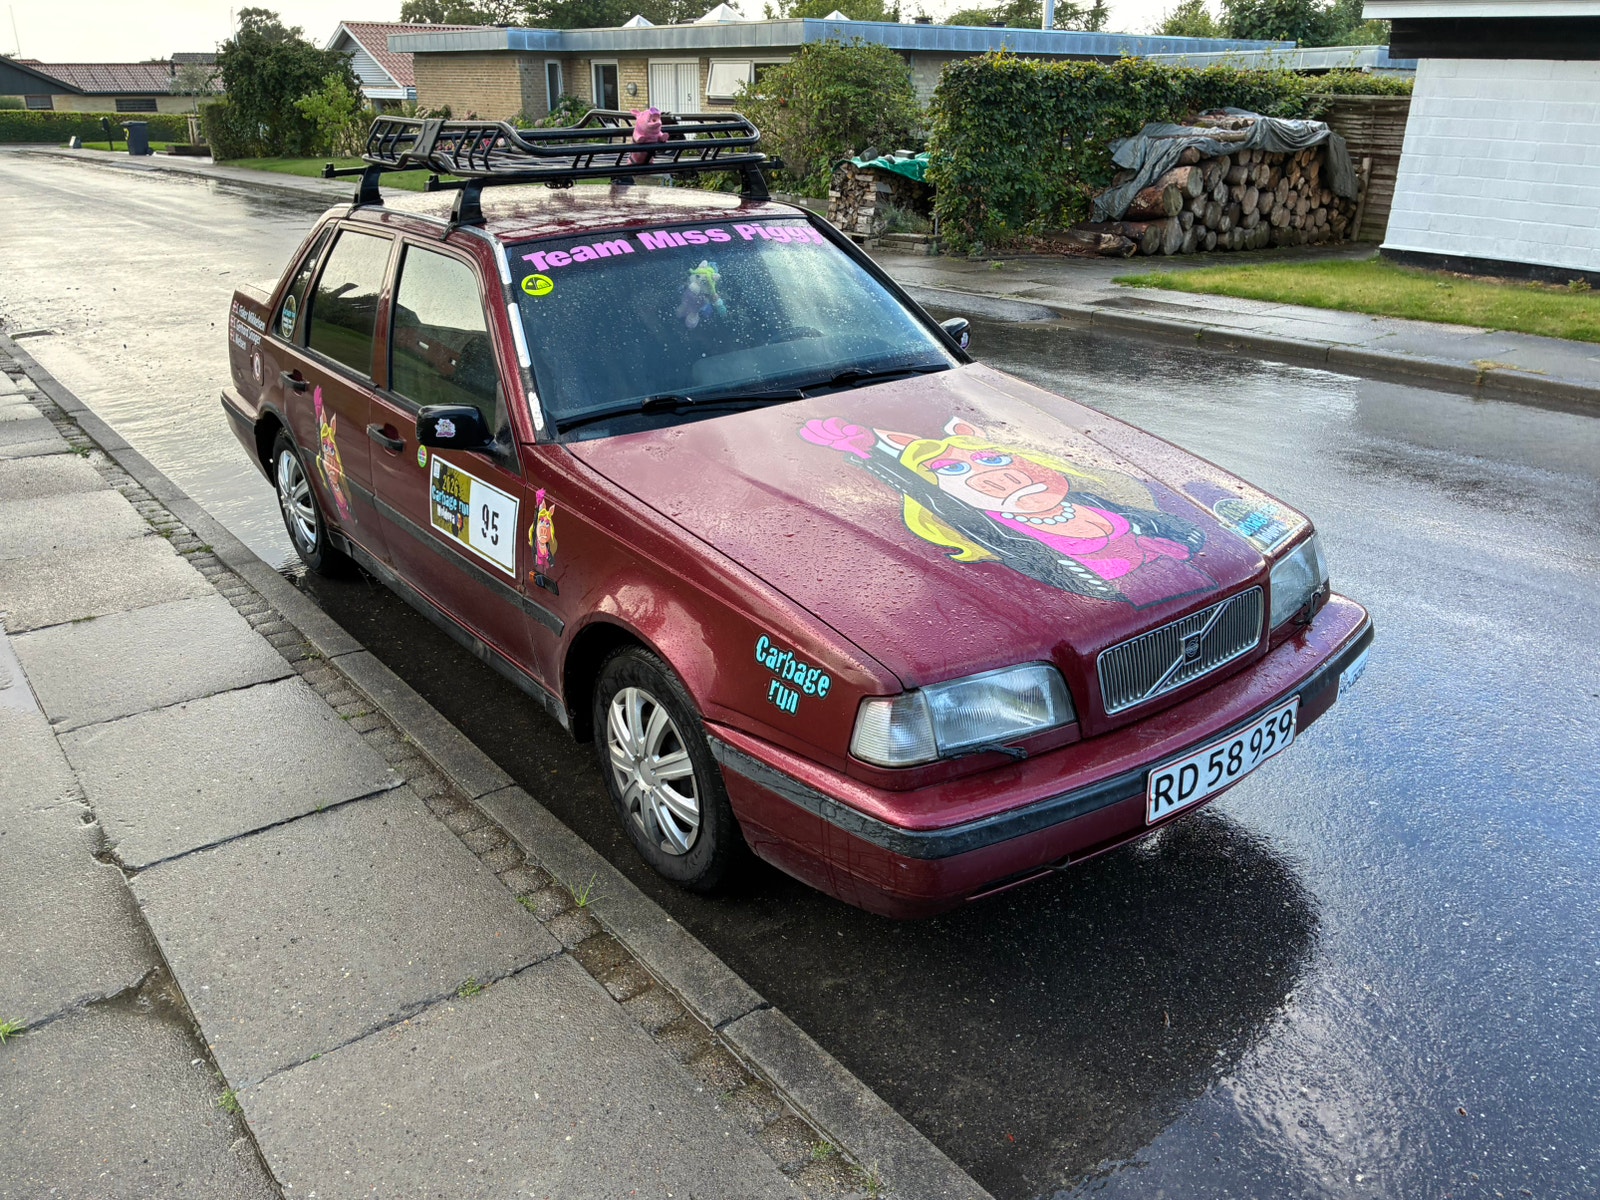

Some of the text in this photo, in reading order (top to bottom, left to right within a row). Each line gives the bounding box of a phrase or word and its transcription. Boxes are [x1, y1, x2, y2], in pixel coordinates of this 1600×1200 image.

[522, 223, 824, 271] Team Miss Piggy
[482, 504, 499, 545] 95
[768, 680, 799, 714] run
[1153, 708, 1293, 813] RD 58 939
